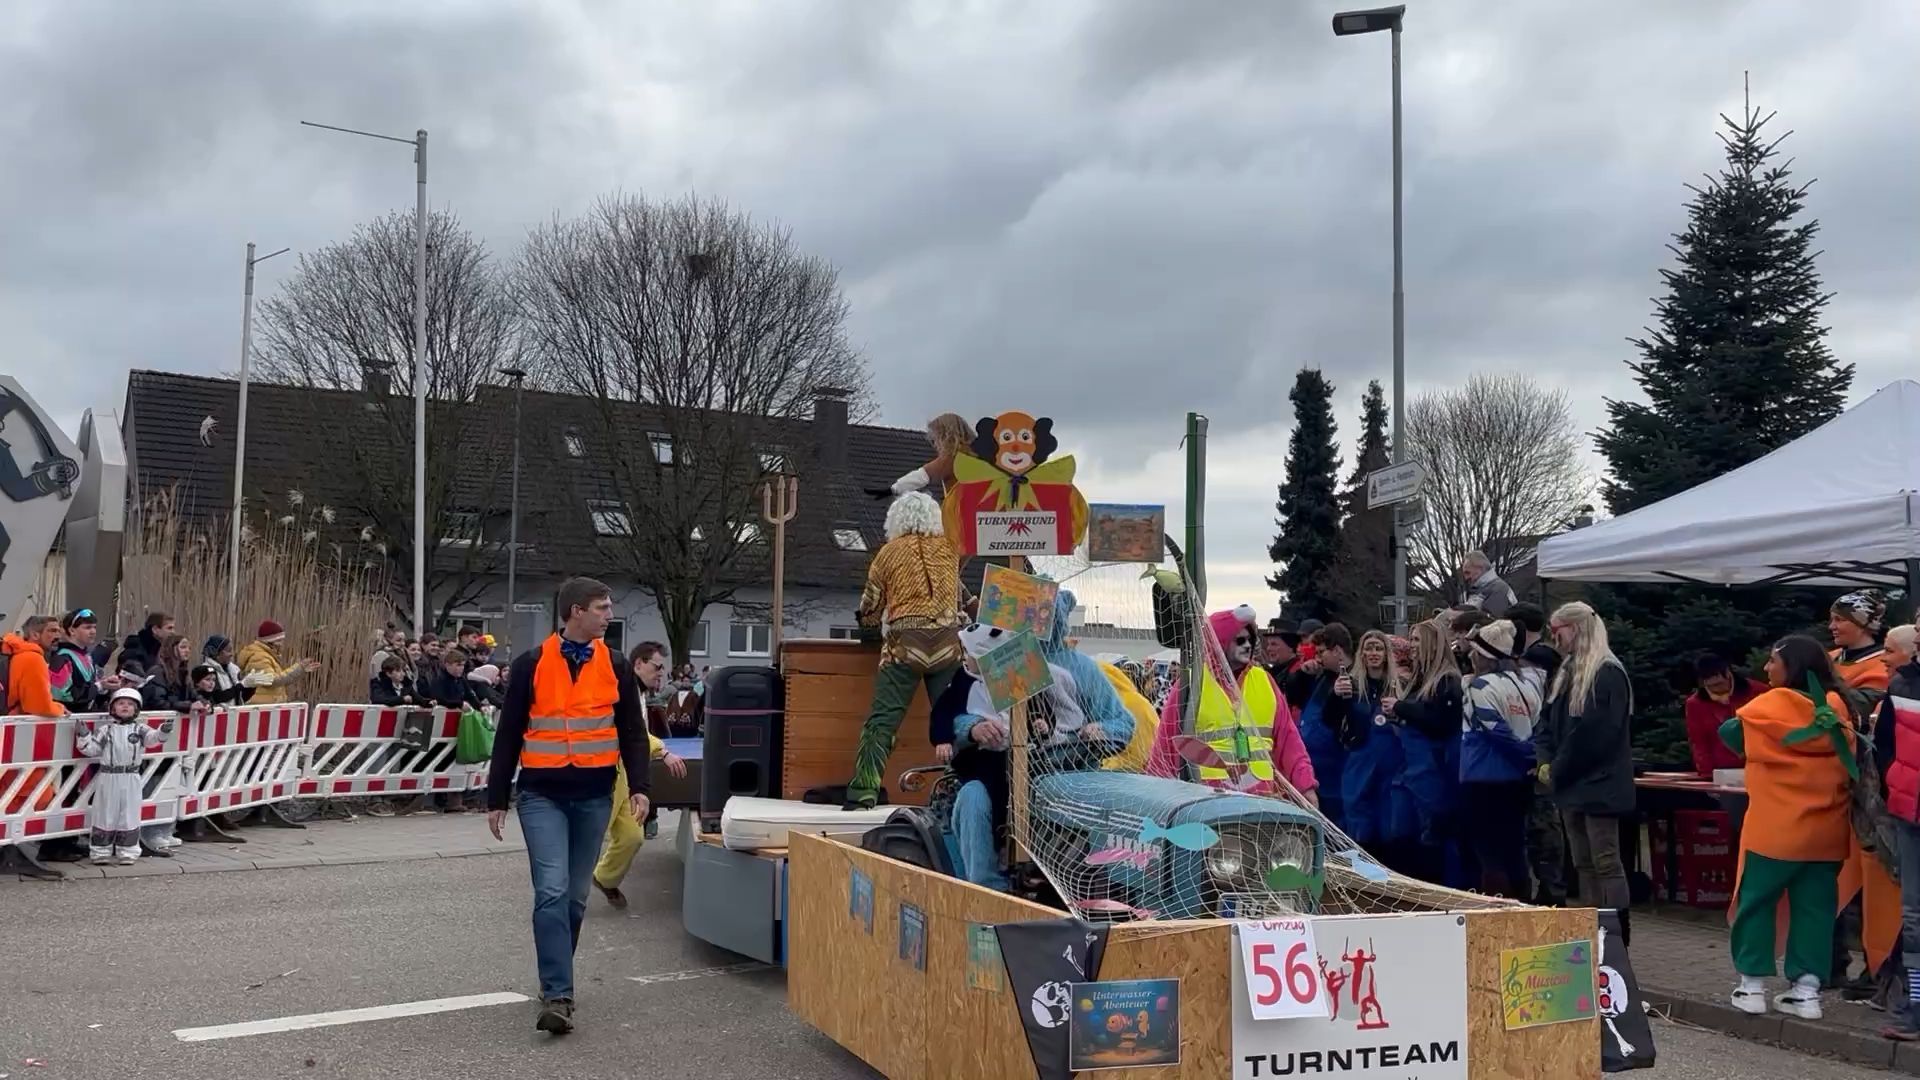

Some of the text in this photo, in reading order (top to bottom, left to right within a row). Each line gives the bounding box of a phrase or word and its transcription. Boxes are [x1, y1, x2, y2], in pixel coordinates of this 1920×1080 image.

[977, 516, 1056, 526] TURNERBUND
[988, 541, 1047, 551] SINZHEIM
[1262, 920, 1307, 936] Umzug
[1252, 942, 1318, 1007] 56
[1102, 1000, 1150, 1010] Abenteuer
[1244, 1040, 1459, 1078] TURNTEAM
